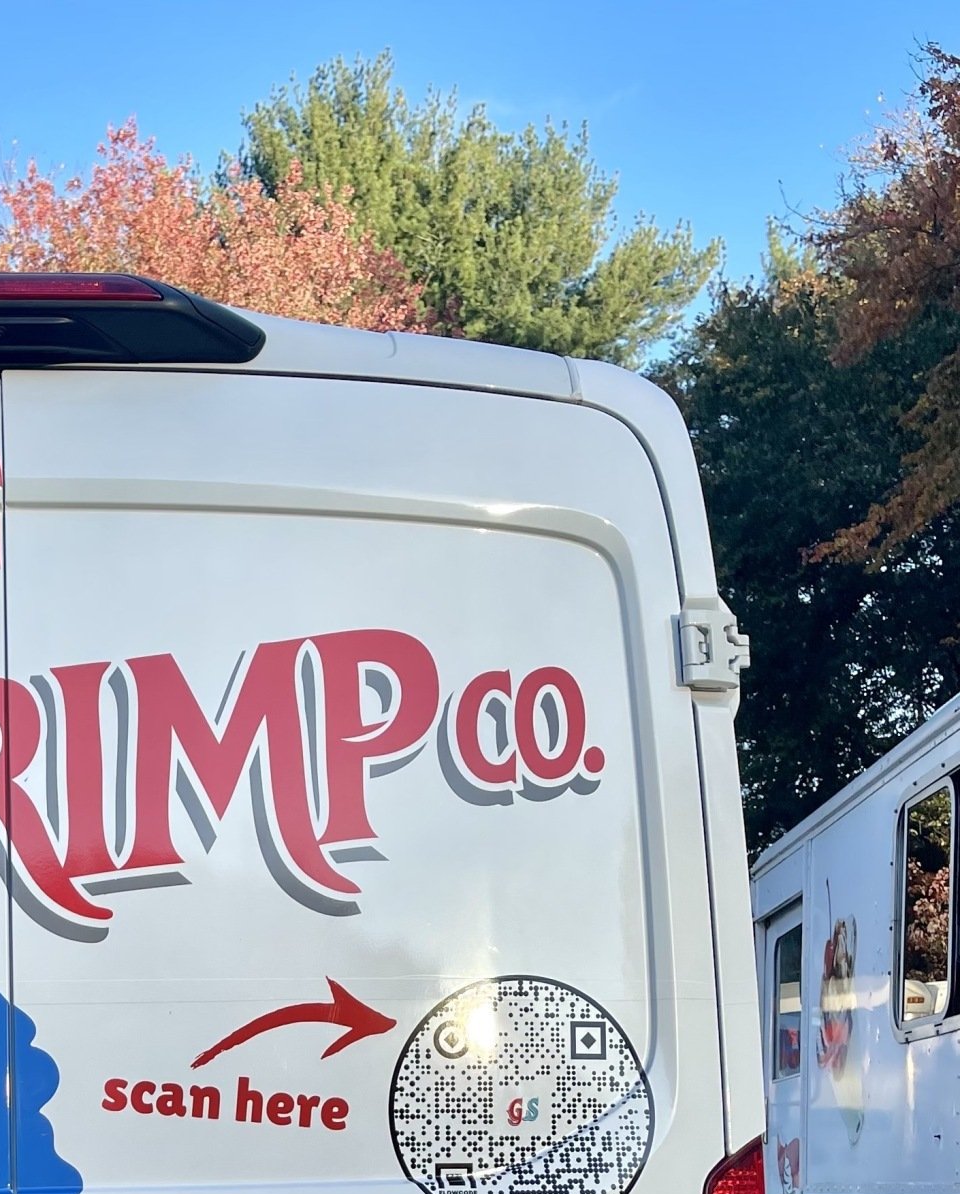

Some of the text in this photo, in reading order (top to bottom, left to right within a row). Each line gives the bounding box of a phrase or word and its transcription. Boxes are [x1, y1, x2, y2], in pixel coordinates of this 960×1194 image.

[454, 664, 607, 785] CO.
[101, 1075, 350, 1131] scan here
